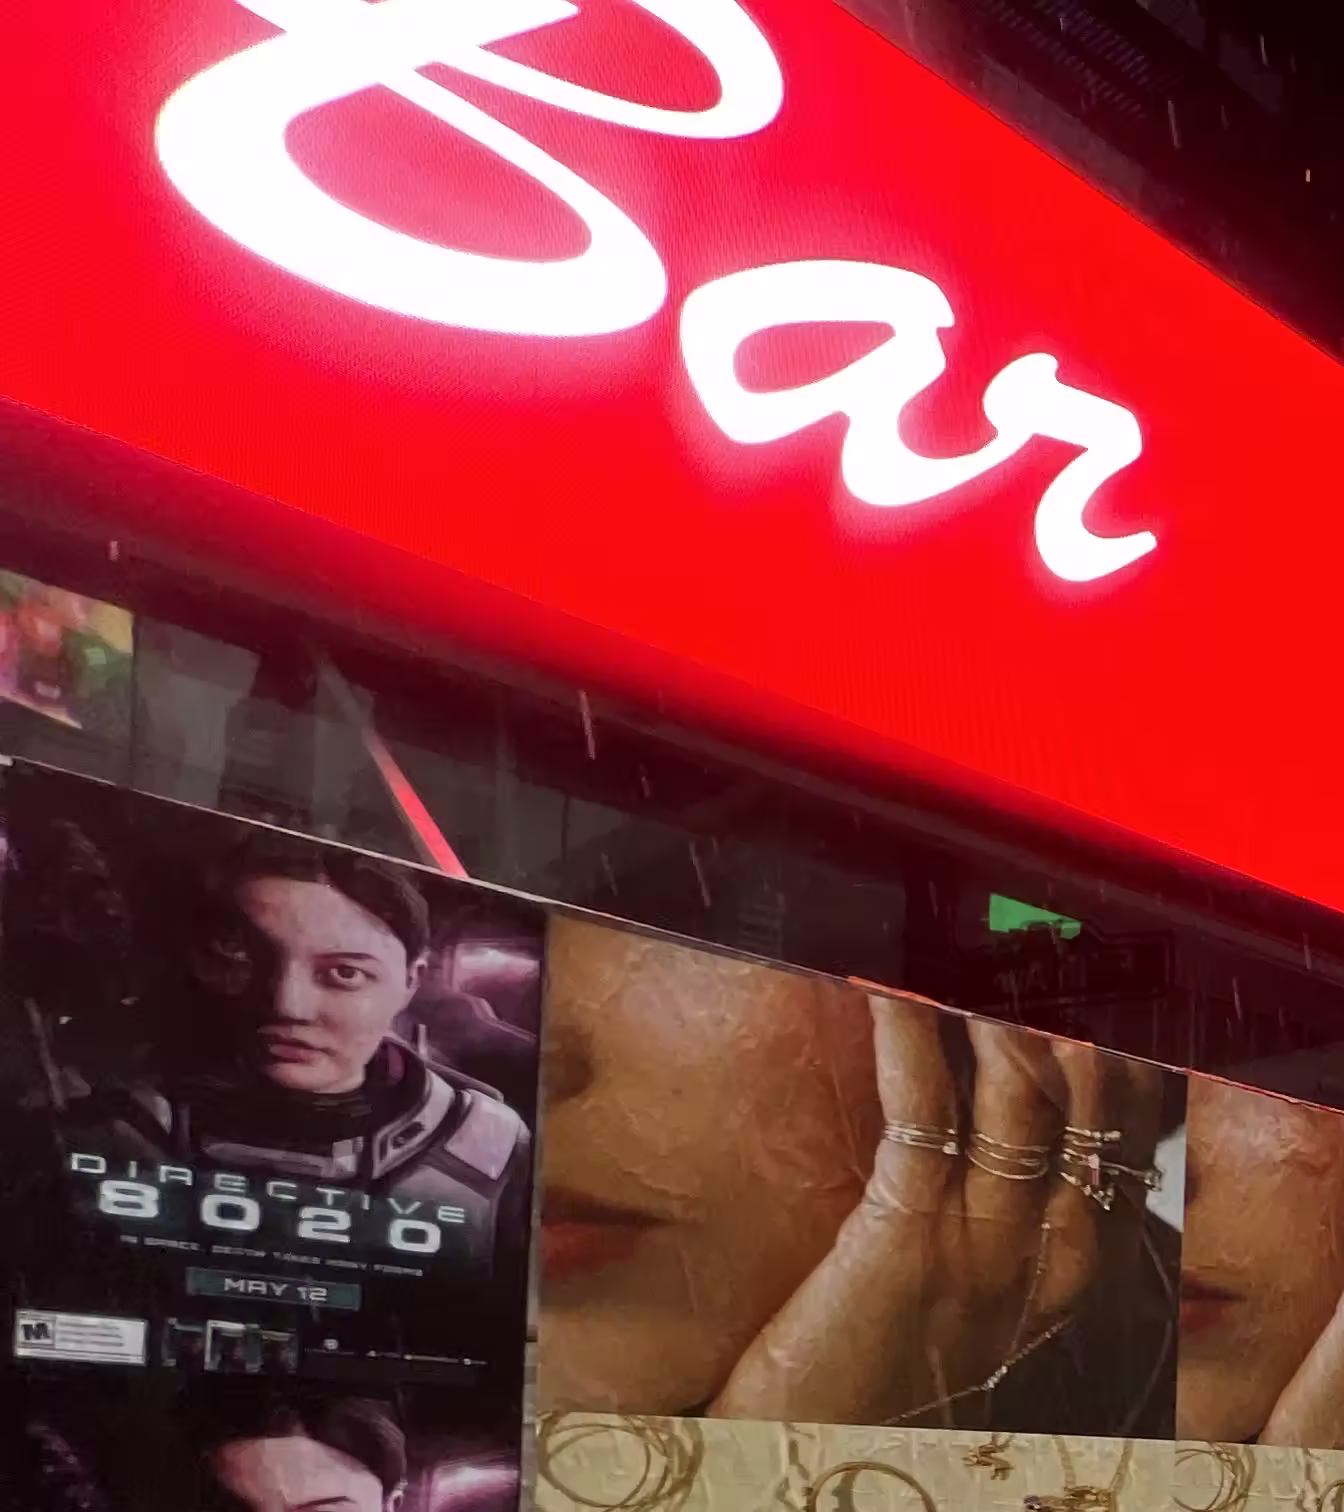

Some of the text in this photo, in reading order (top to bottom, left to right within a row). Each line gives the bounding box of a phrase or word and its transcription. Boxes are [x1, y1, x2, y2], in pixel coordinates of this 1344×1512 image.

[70, 1152, 466, 1224] DIRECTIVE
[99, 1179, 442, 1254] 8020
[223, 1277, 328, 1302] MAY 12
